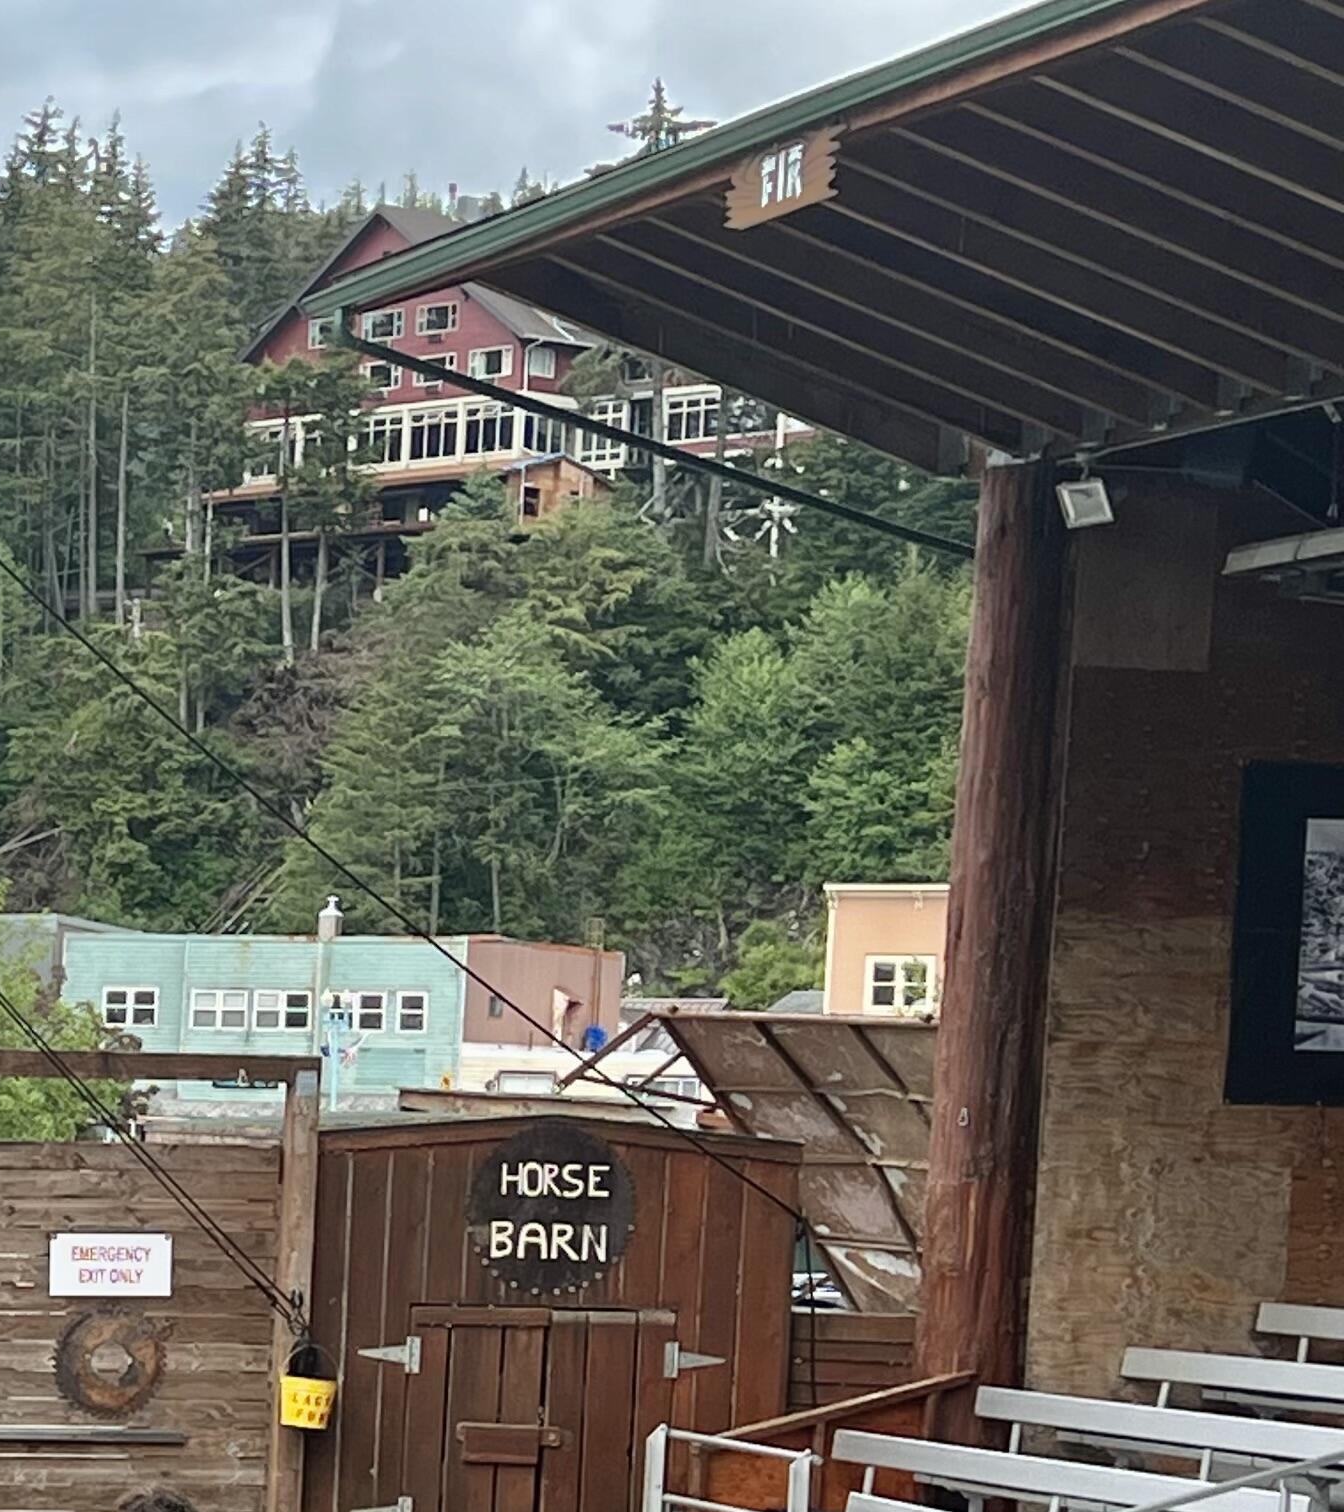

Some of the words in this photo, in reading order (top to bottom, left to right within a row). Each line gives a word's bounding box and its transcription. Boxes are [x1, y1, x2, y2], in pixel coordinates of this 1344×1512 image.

[761, 144, 804, 208] FIR
[500, 1161, 611, 1198] HORSE
[72, 1246, 152, 1261] EMERGENCY
[489, 1220, 608, 1263] BARN
[79, 1269, 106, 1283] EXIT
[109, 1269, 143, 1283] ONLY
